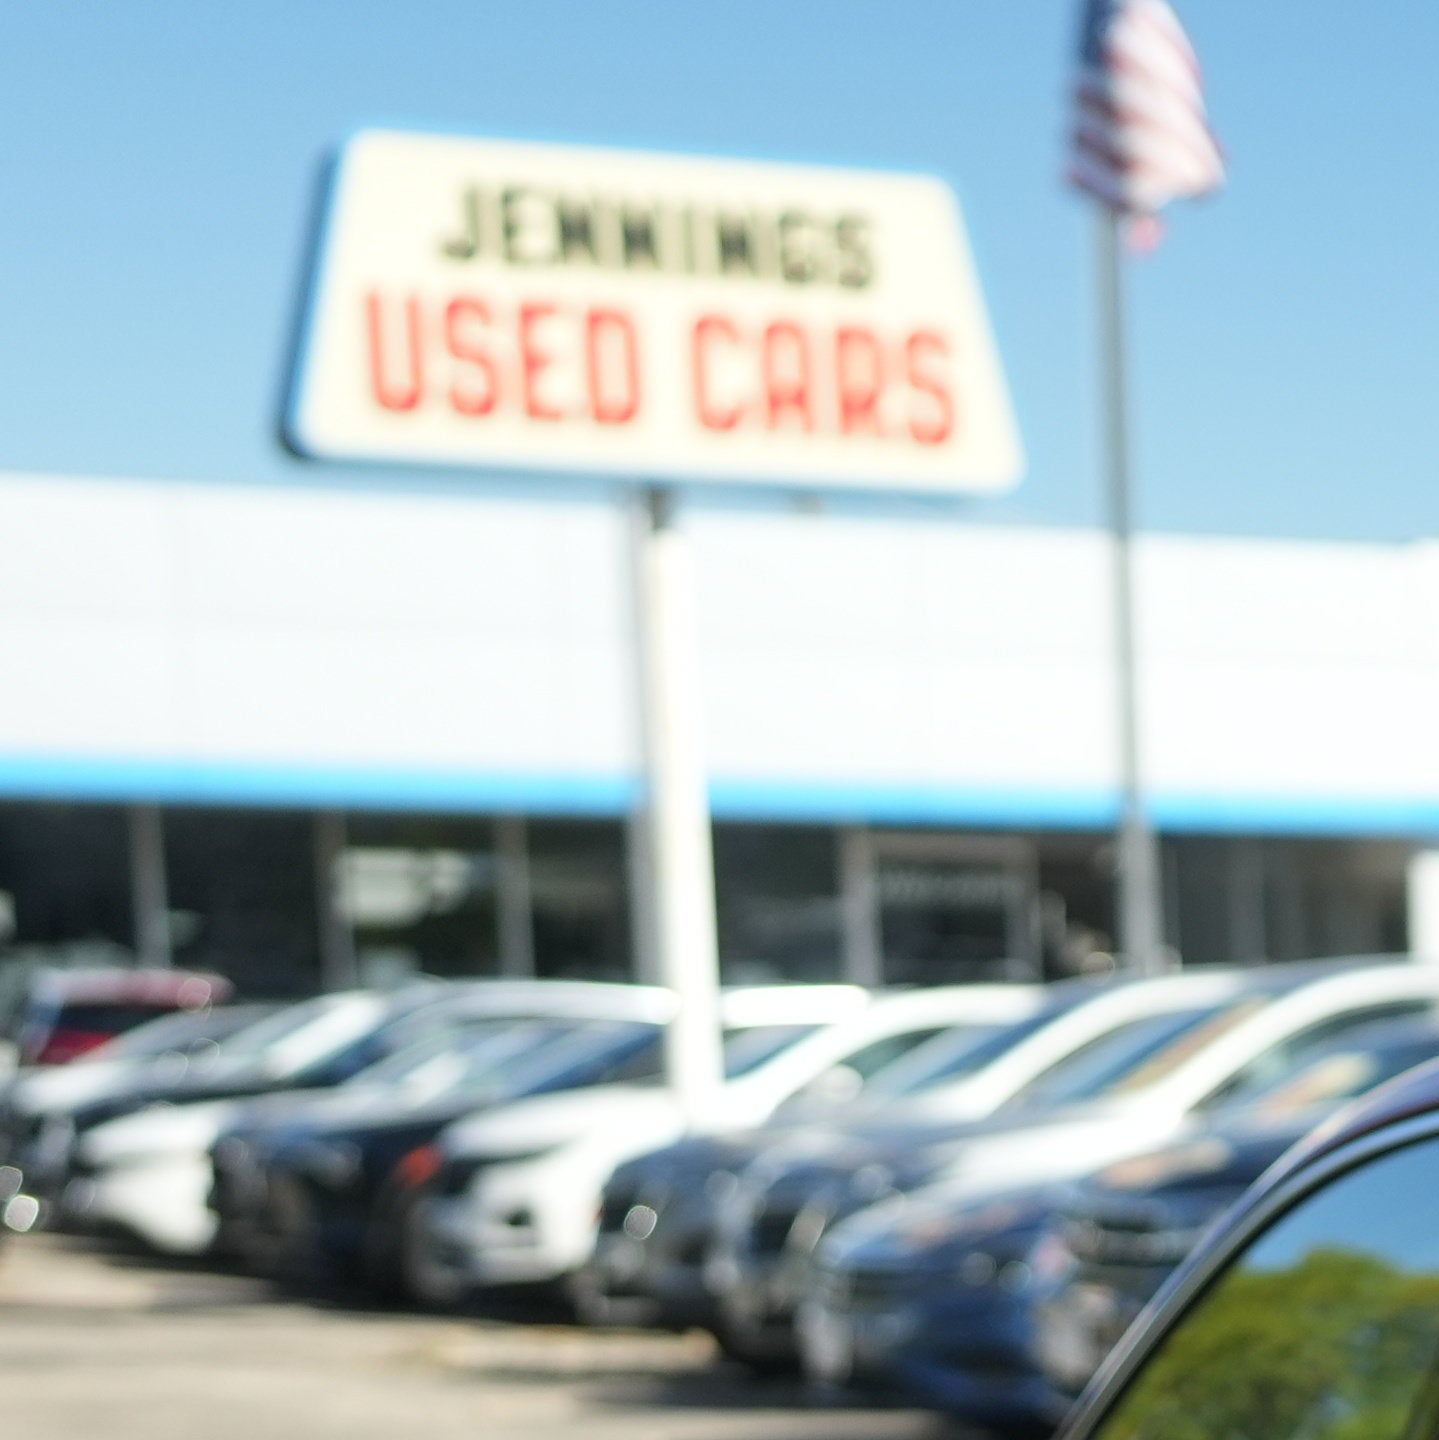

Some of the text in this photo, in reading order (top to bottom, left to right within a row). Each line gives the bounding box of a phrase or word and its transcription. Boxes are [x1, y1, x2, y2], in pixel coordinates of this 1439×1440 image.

[440, 184, 876, 290] JENNINGS
[365, 287, 956, 446] USED CARS
